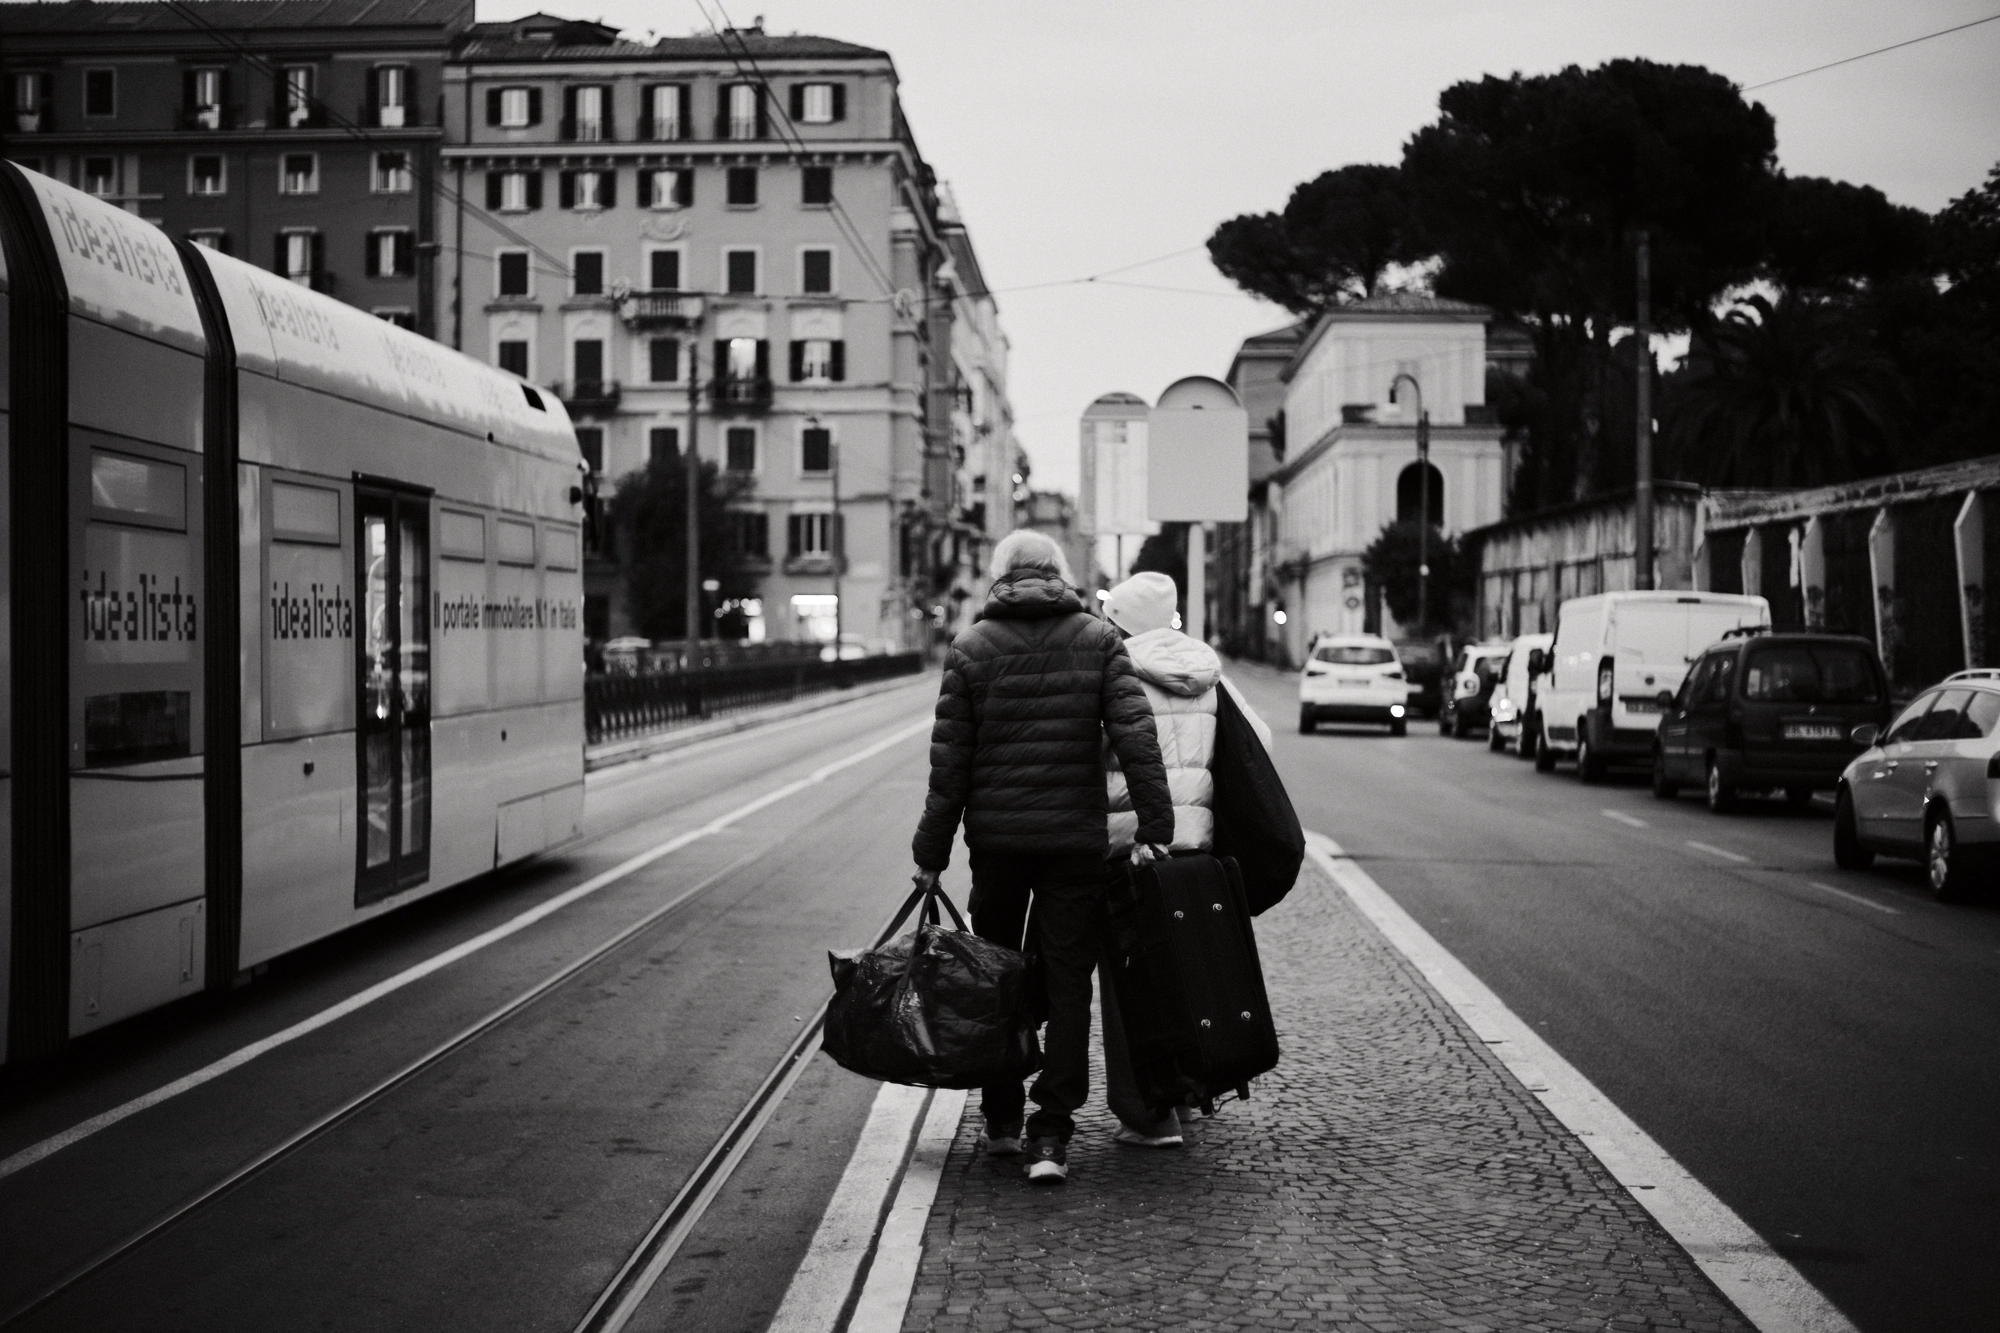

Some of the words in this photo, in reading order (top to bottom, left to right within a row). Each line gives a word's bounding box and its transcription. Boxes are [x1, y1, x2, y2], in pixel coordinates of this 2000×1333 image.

[46, 189, 183, 296] idealista
[80, 570, 196, 641] idealista
[271, 581, 352, 639] idealista
[443, 594, 479, 636] portale
